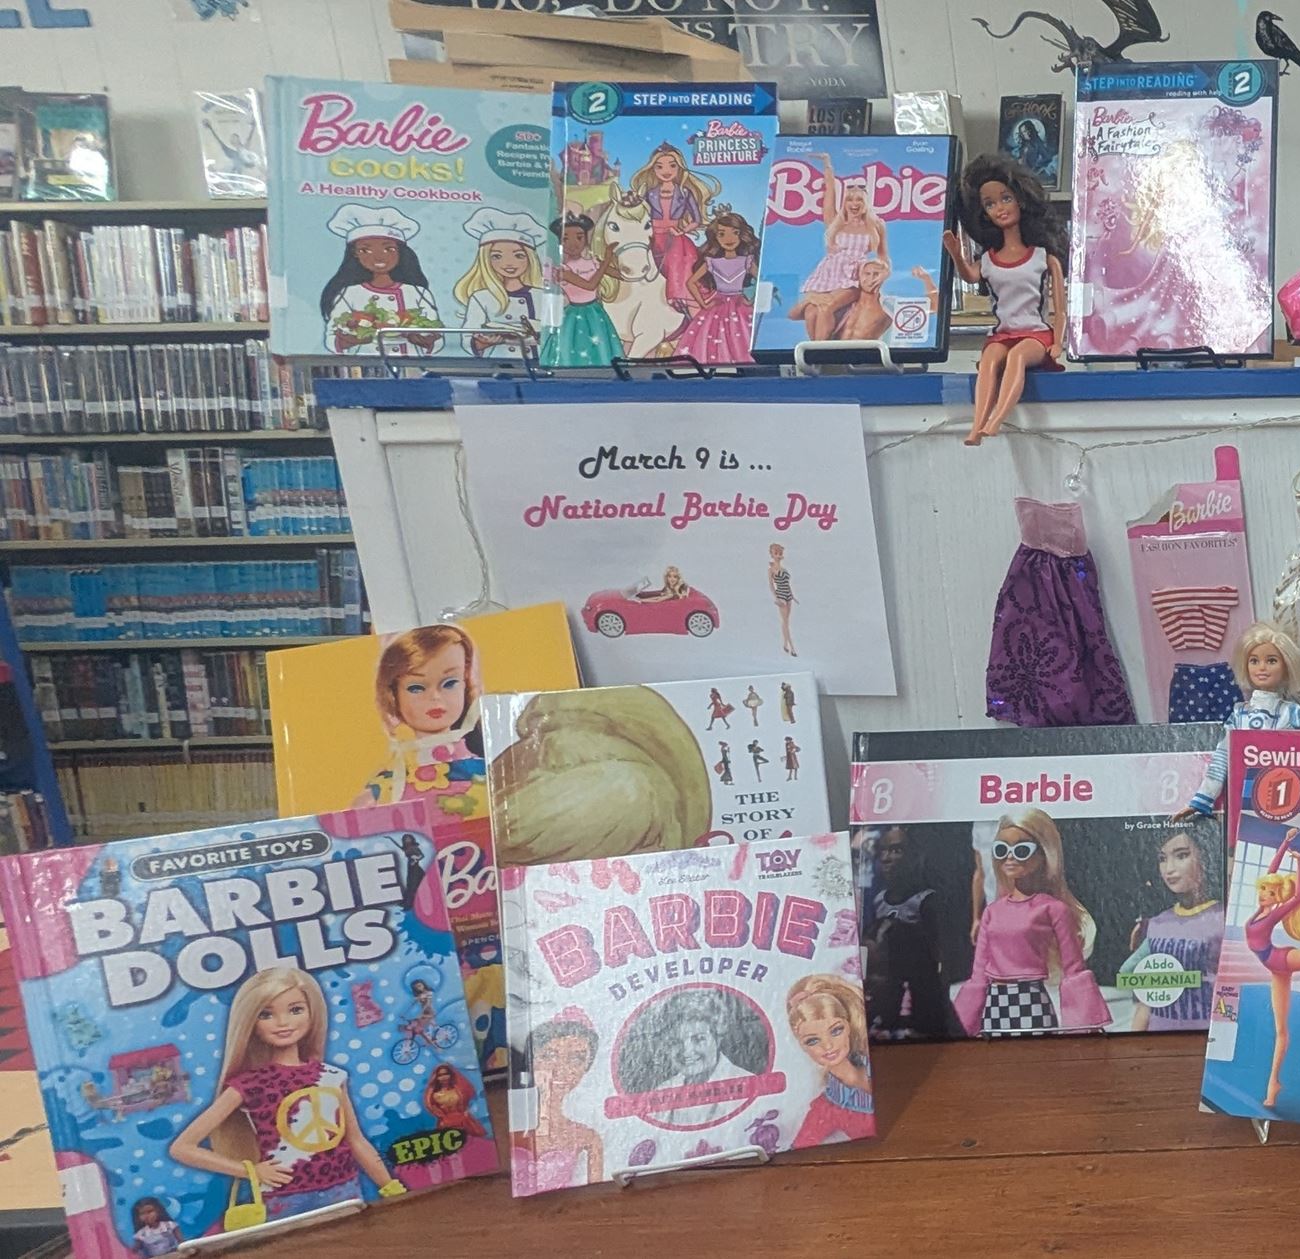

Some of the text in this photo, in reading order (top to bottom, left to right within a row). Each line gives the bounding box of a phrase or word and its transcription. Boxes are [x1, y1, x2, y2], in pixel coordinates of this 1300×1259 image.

[728, 23, 870, 67] TRY
[1085, 74, 1194, 91] STEP INTO READING
[1233, 71, 1251, 95] 2
[588, 92, 607, 114] 2
[633, 94, 753, 106] STEP INTO READING
[298, 92, 469, 153] Barbie
[706, 120, 749, 138] Barbie
[1096, 126, 1151, 140] A Fashion
[697, 138, 757, 152] PRINCESS
[695, 150, 759, 165] ADVENTURE
[300, 182, 483, 202] A Healthy Cookbook
[766, 160, 946, 219] Barbie
[579, 445, 740, 479] March 9 is
[524, 492, 838, 531] National Barbie Day
[1168, 489, 1233, 533] Barbie
[1141, 540, 1181, 553] FASHION
[735, 791, 780, 806] THE
[979, 773, 1094, 804] Barbie
[1276, 780, 1288, 806] 1
[721, 808, 795, 825] STORY
[1124, 820, 1194, 831] by Grace Hansen
[743, 829, 772, 841] OF
[150, 838, 314, 875] FAVORITE TOYS
[755, 849, 802, 874] TOY
[70, 853, 404, 956] BARBIE
[536, 889, 828, 988] BARBIE
[101, 909, 395, 1007] DOLLS
[1143, 958, 1175, 970] Abdo
[608, 956, 769, 1001] DEVELOPER
[1121, 973, 1197, 987] TOY MANIA!
[1146, 991, 1172, 1002] Kids
[392, 1129, 465, 1165] EPIC
